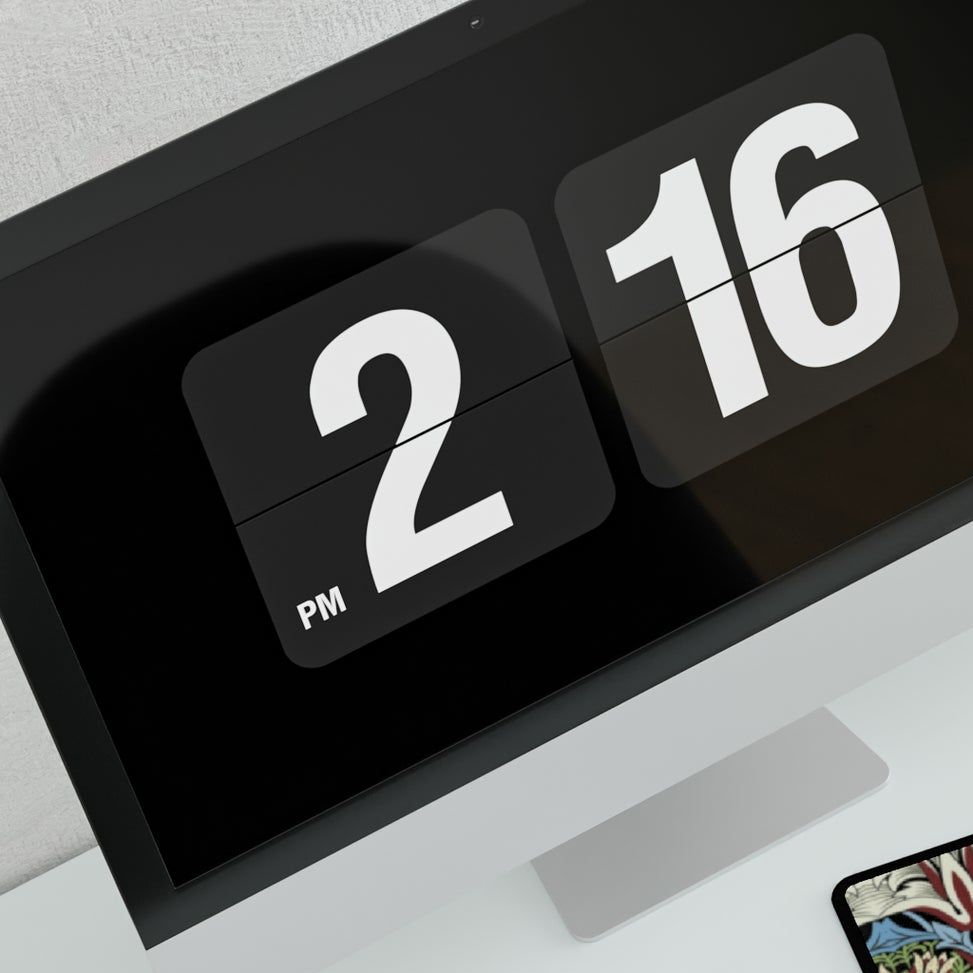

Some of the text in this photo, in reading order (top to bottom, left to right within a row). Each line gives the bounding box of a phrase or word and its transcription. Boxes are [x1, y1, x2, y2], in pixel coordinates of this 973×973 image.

[310, 103, 900, 594] 2 16
[297, 585, 347, 631] PM
